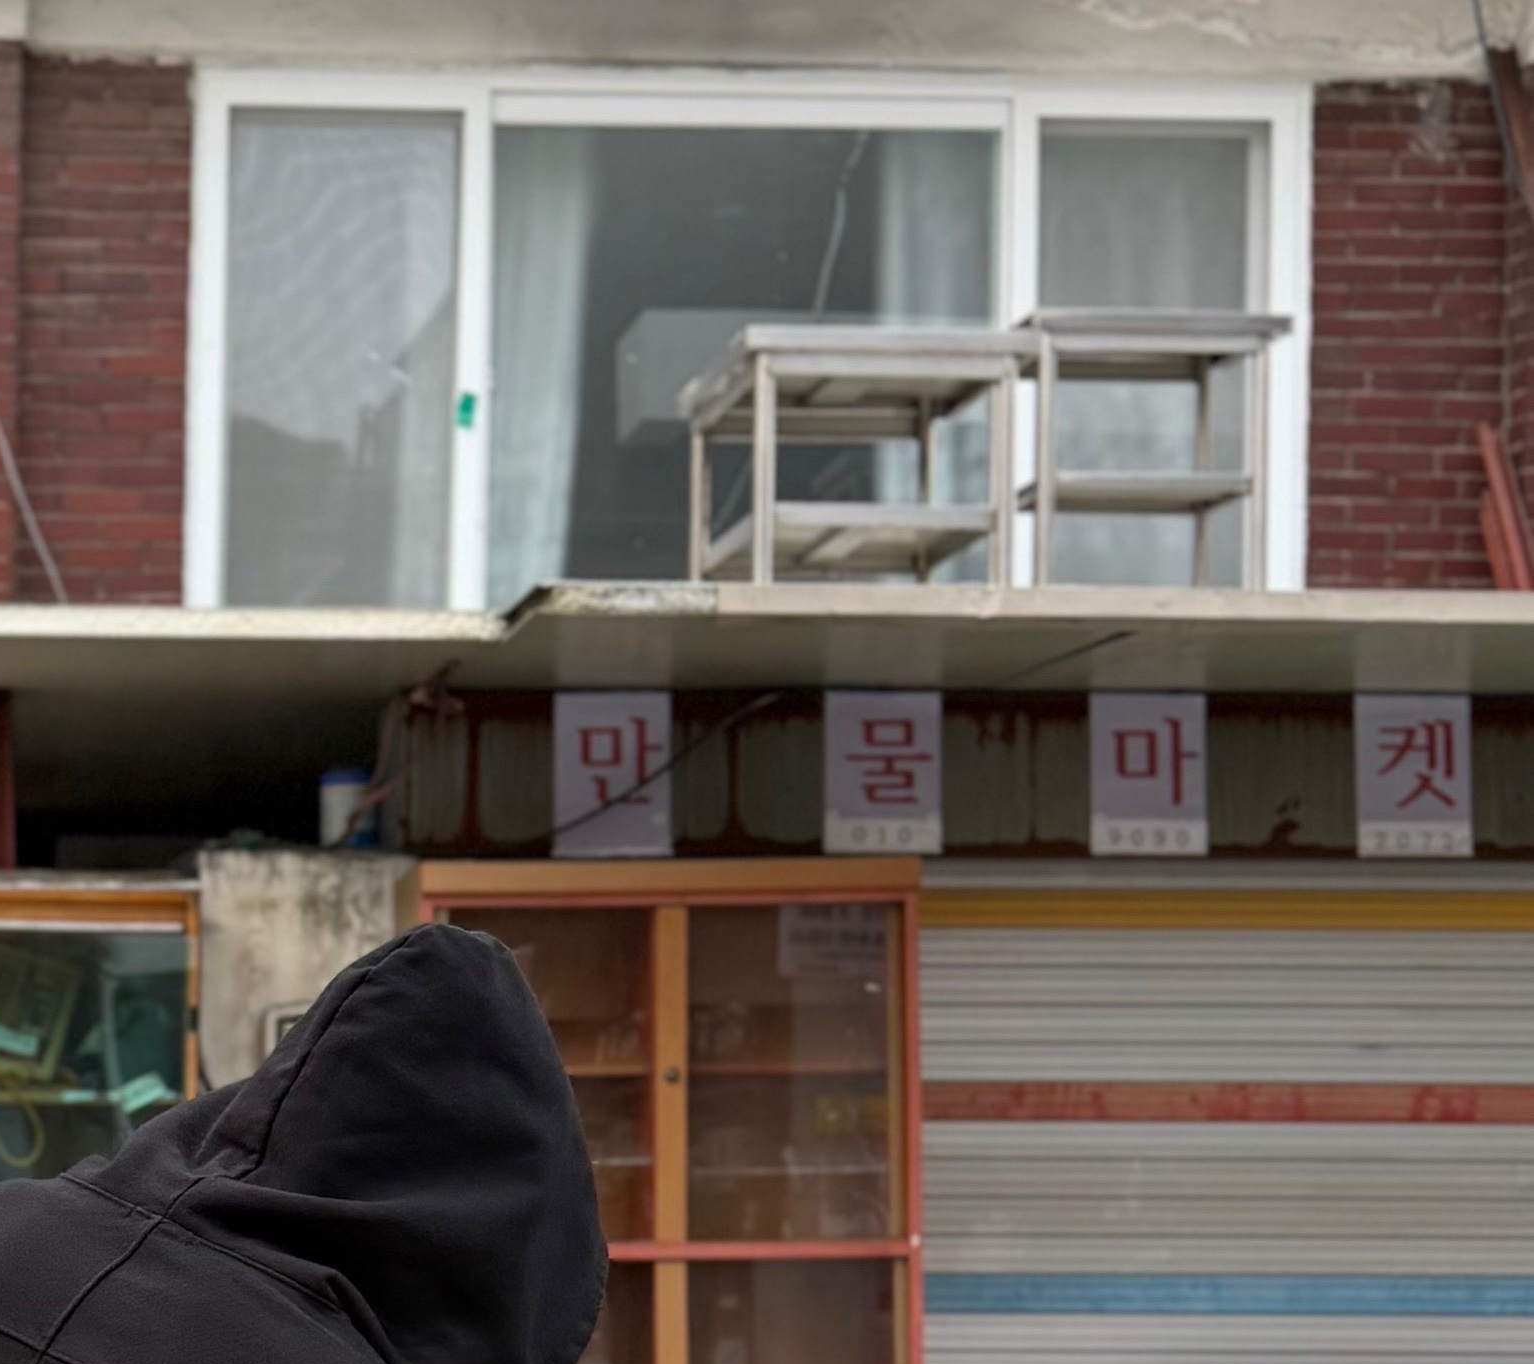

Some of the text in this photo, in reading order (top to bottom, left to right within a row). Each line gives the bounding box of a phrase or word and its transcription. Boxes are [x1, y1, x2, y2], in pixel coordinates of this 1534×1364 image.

[845, 718, 933, 805] 물
[1112, 716, 1199, 807] 마
[1377, 717, 1456, 810] 켓
[850, 824, 913, 845] 010
